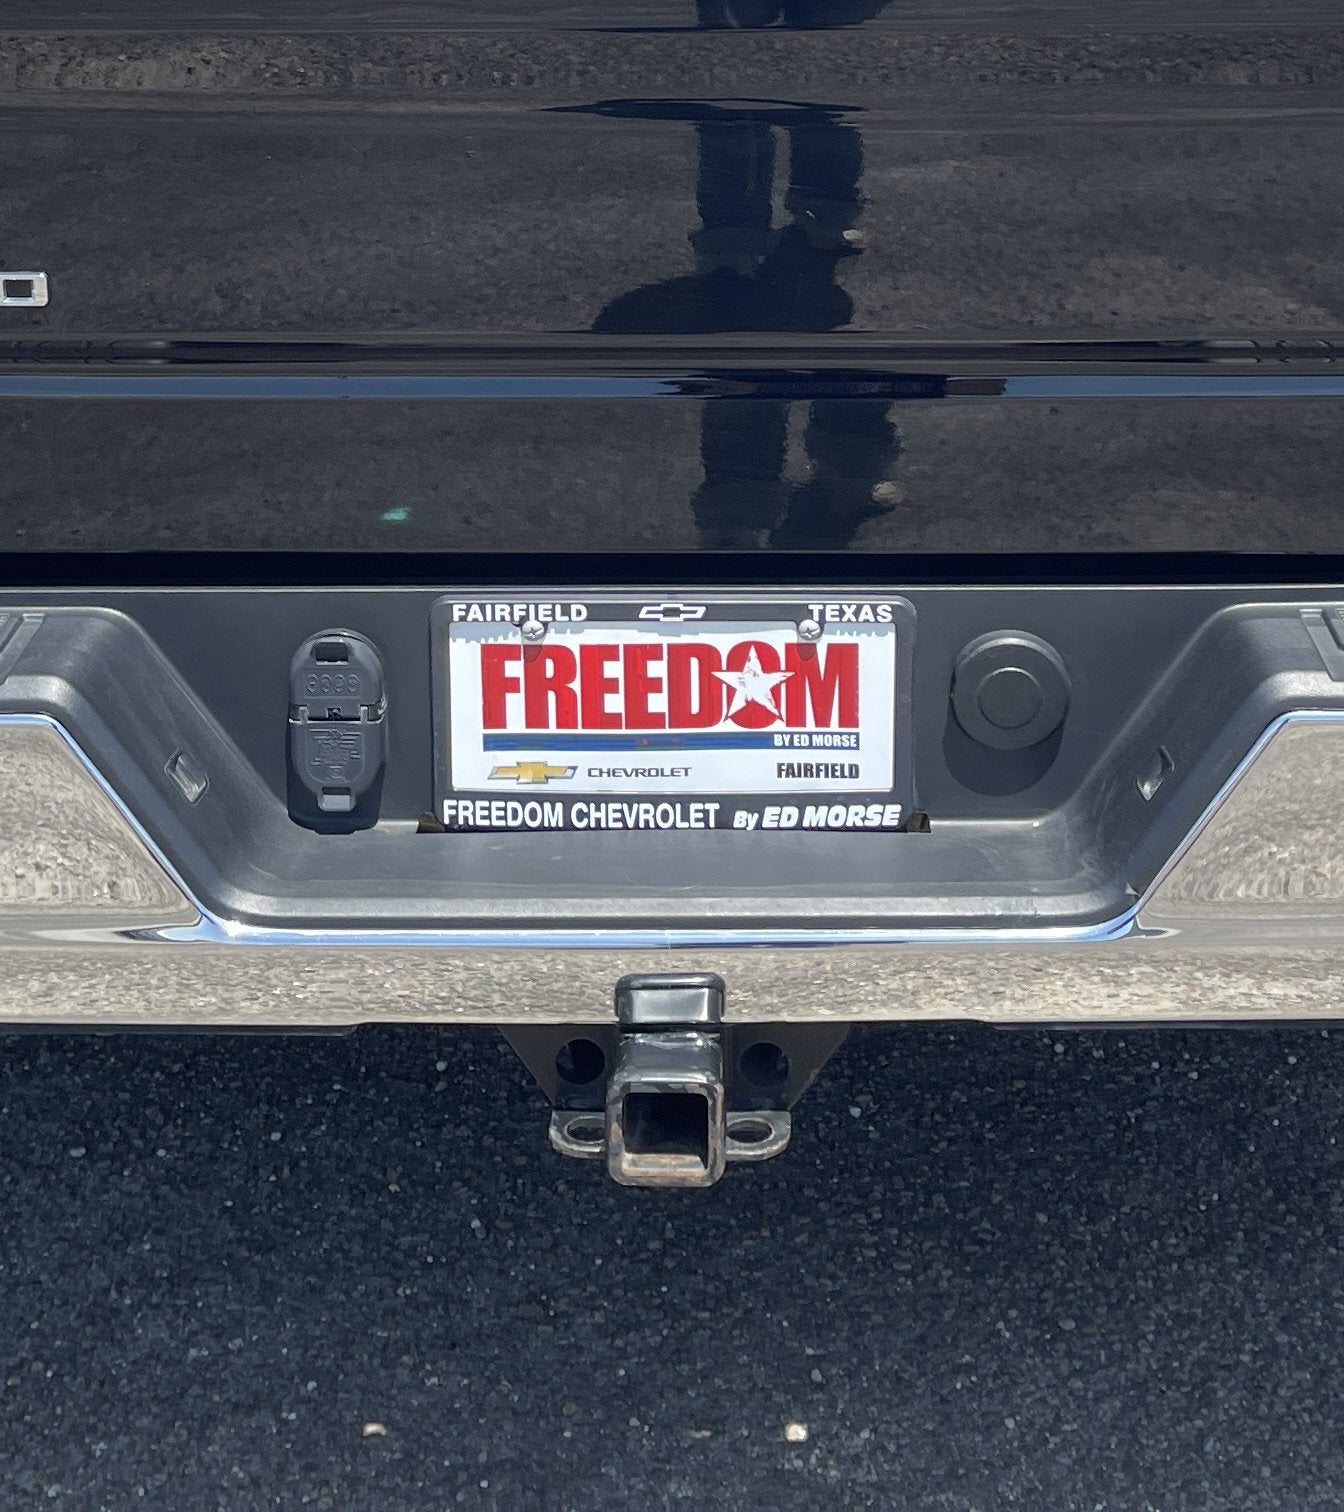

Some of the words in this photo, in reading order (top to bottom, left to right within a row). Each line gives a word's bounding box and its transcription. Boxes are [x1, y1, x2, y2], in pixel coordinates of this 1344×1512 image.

[452, 603, 588, 623] FAIRFIELD
[808, 603, 893, 623] TEXAS
[481, 641, 859, 729] FREEDOM
[773, 734, 790, 747] BY
[793, 734, 810, 747] ED
[812, 734, 858, 748] MORSE
[587, 766, 692, 778] CHEVROLET
[776, 762, 860, 779] FAIRFIELD
[442, 799, 564, 828] FREEDOM
[570, 801, 720, 829] CHEVROLET
[732, 810, 758, 831] By
[762, 807, 800, 828] ED
[802, 804, 902, 827] MORSE
